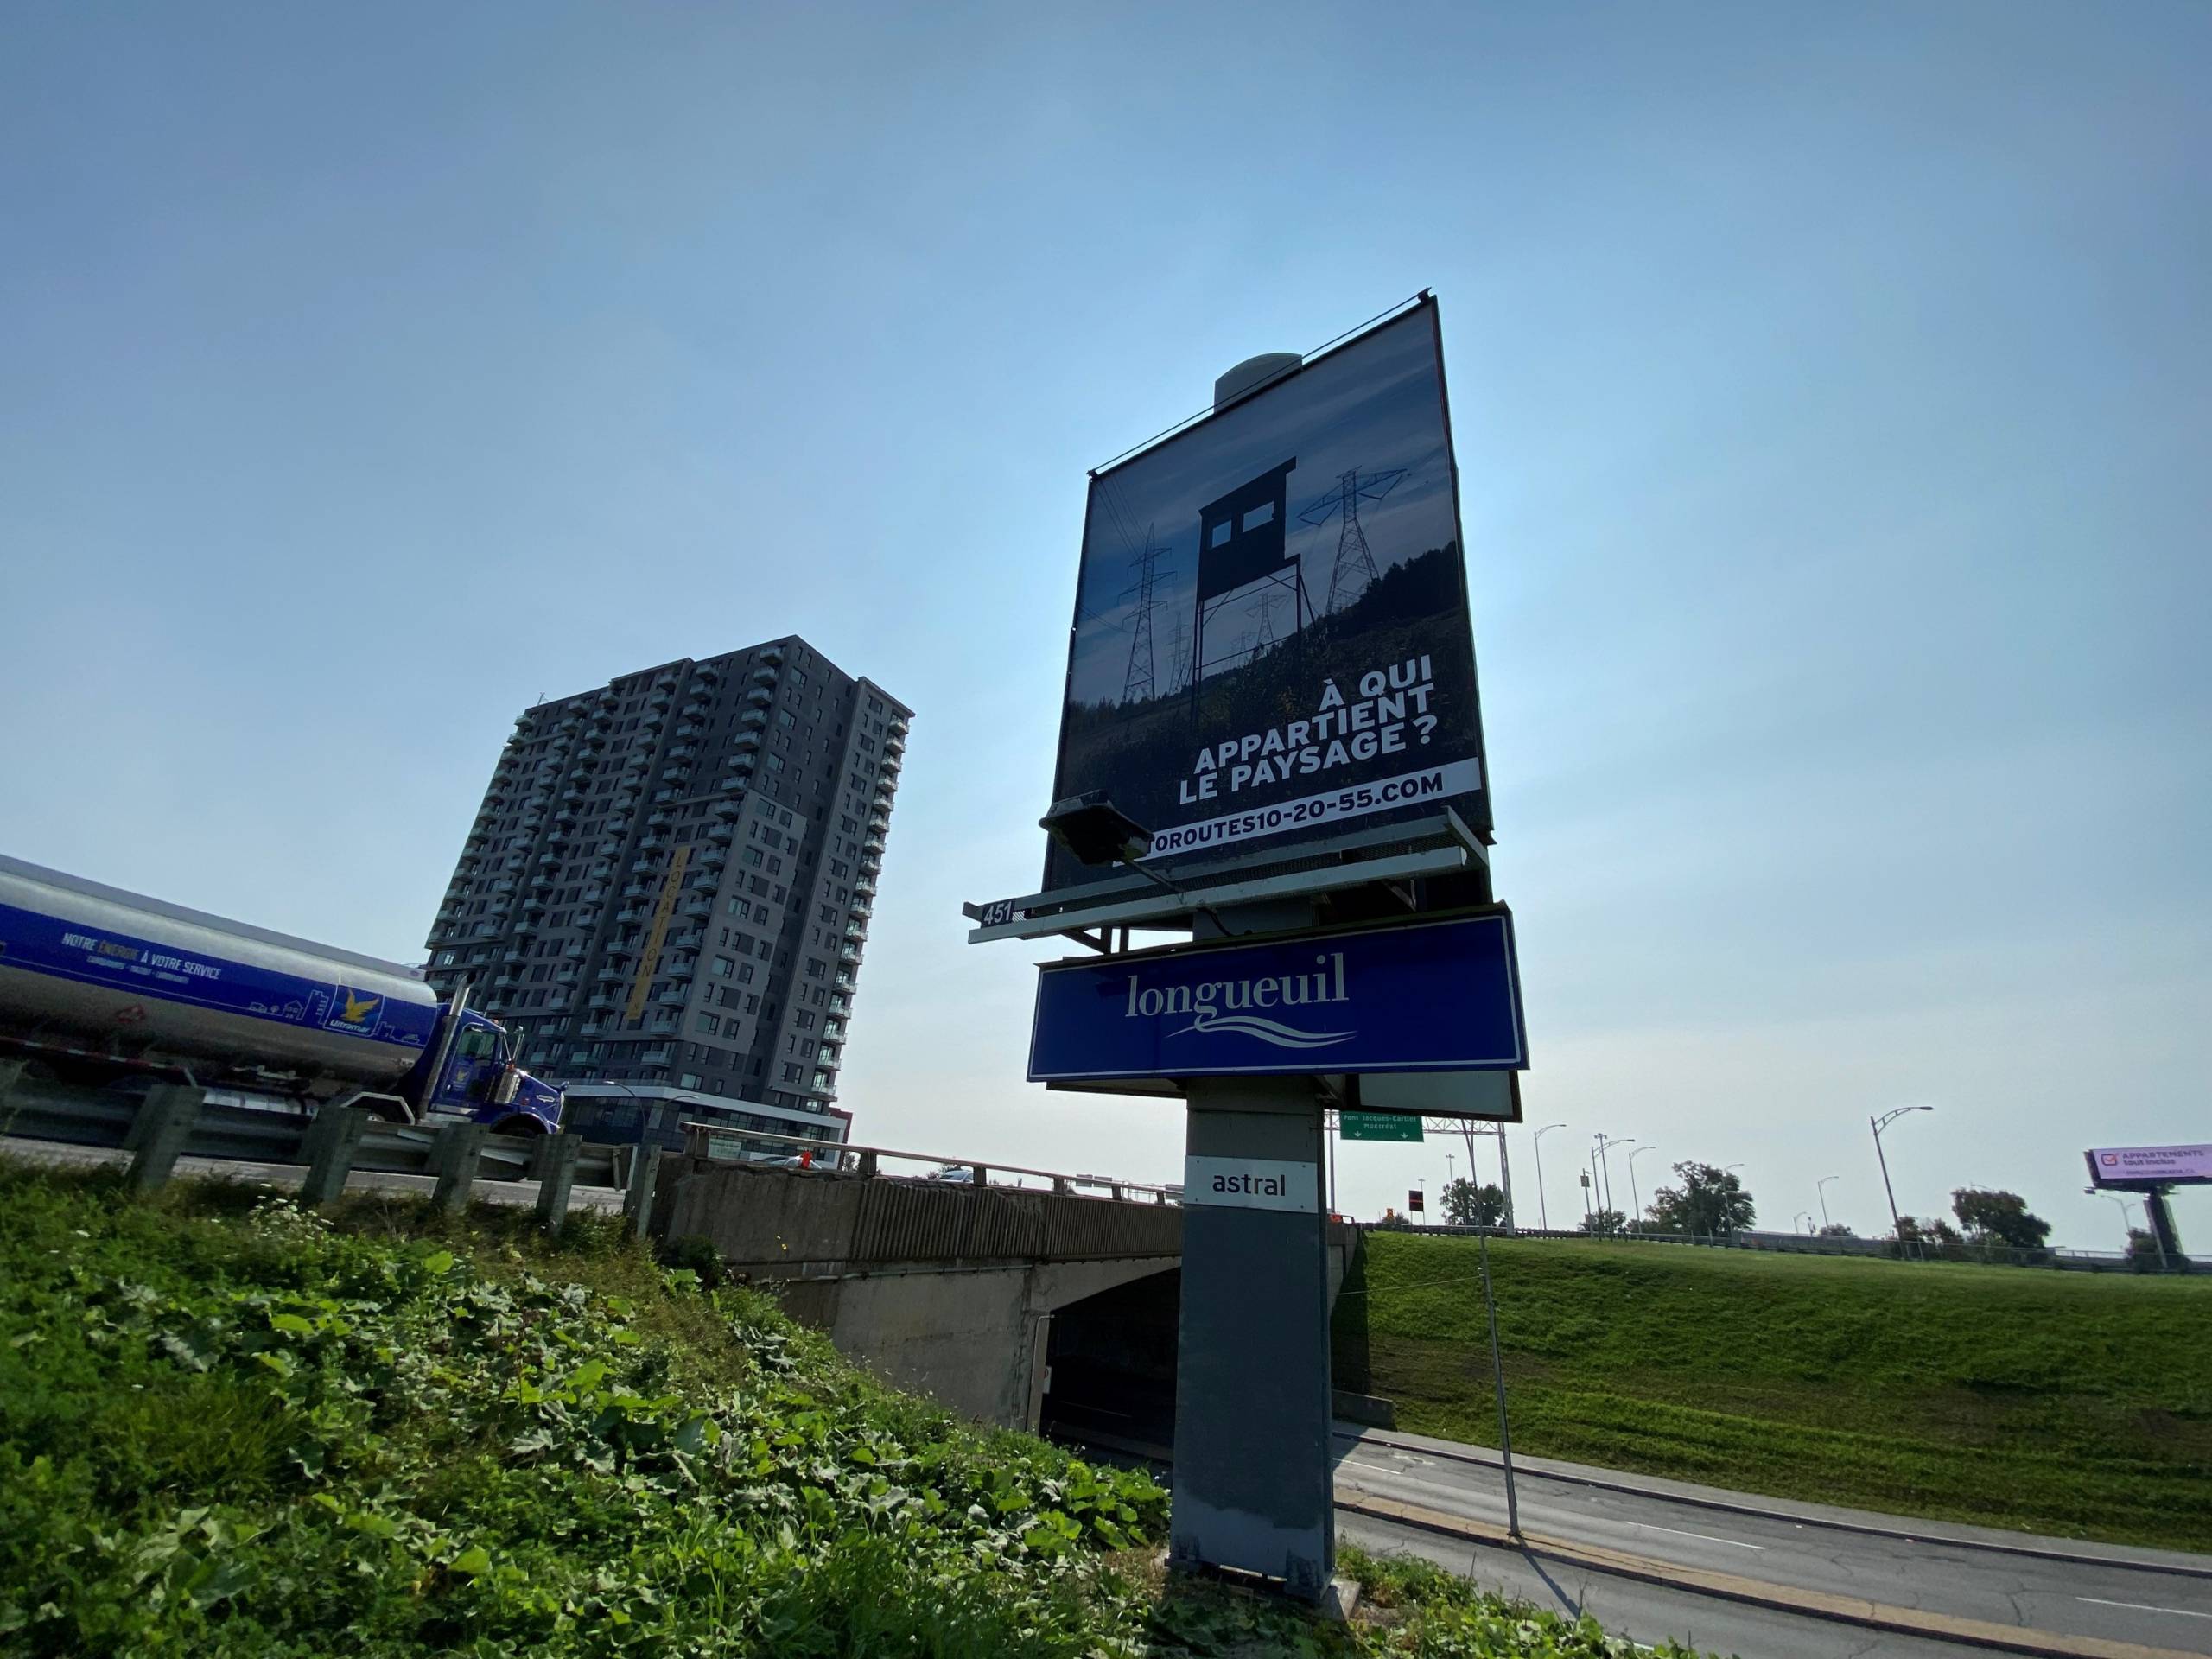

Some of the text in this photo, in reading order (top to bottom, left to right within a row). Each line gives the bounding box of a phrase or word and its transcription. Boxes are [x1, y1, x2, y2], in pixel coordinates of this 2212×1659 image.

[1319, 654, 1433, 712] À QUI
[1193, 683, 1435, 775] APPARTIENT
[1179, 714, 1438, 805] LE PAYSAGE ?
[1148, 772, 1444, 854] TOROUTES10-20-55.COM
[983, 901, 1013, 925] 451
[60, 932, 98, 951] NOTRE
[140, 950, 149, 963] À
[150, 953, 183, 972] VOTRE
[181, 961, 222, 980] SERVICE
[1125, 952, 1350, 1030] longueuil
[2122, 1149, 2205, 1160] APPARTEMENTS
[1212, 1173, 1286, 1197] astral
